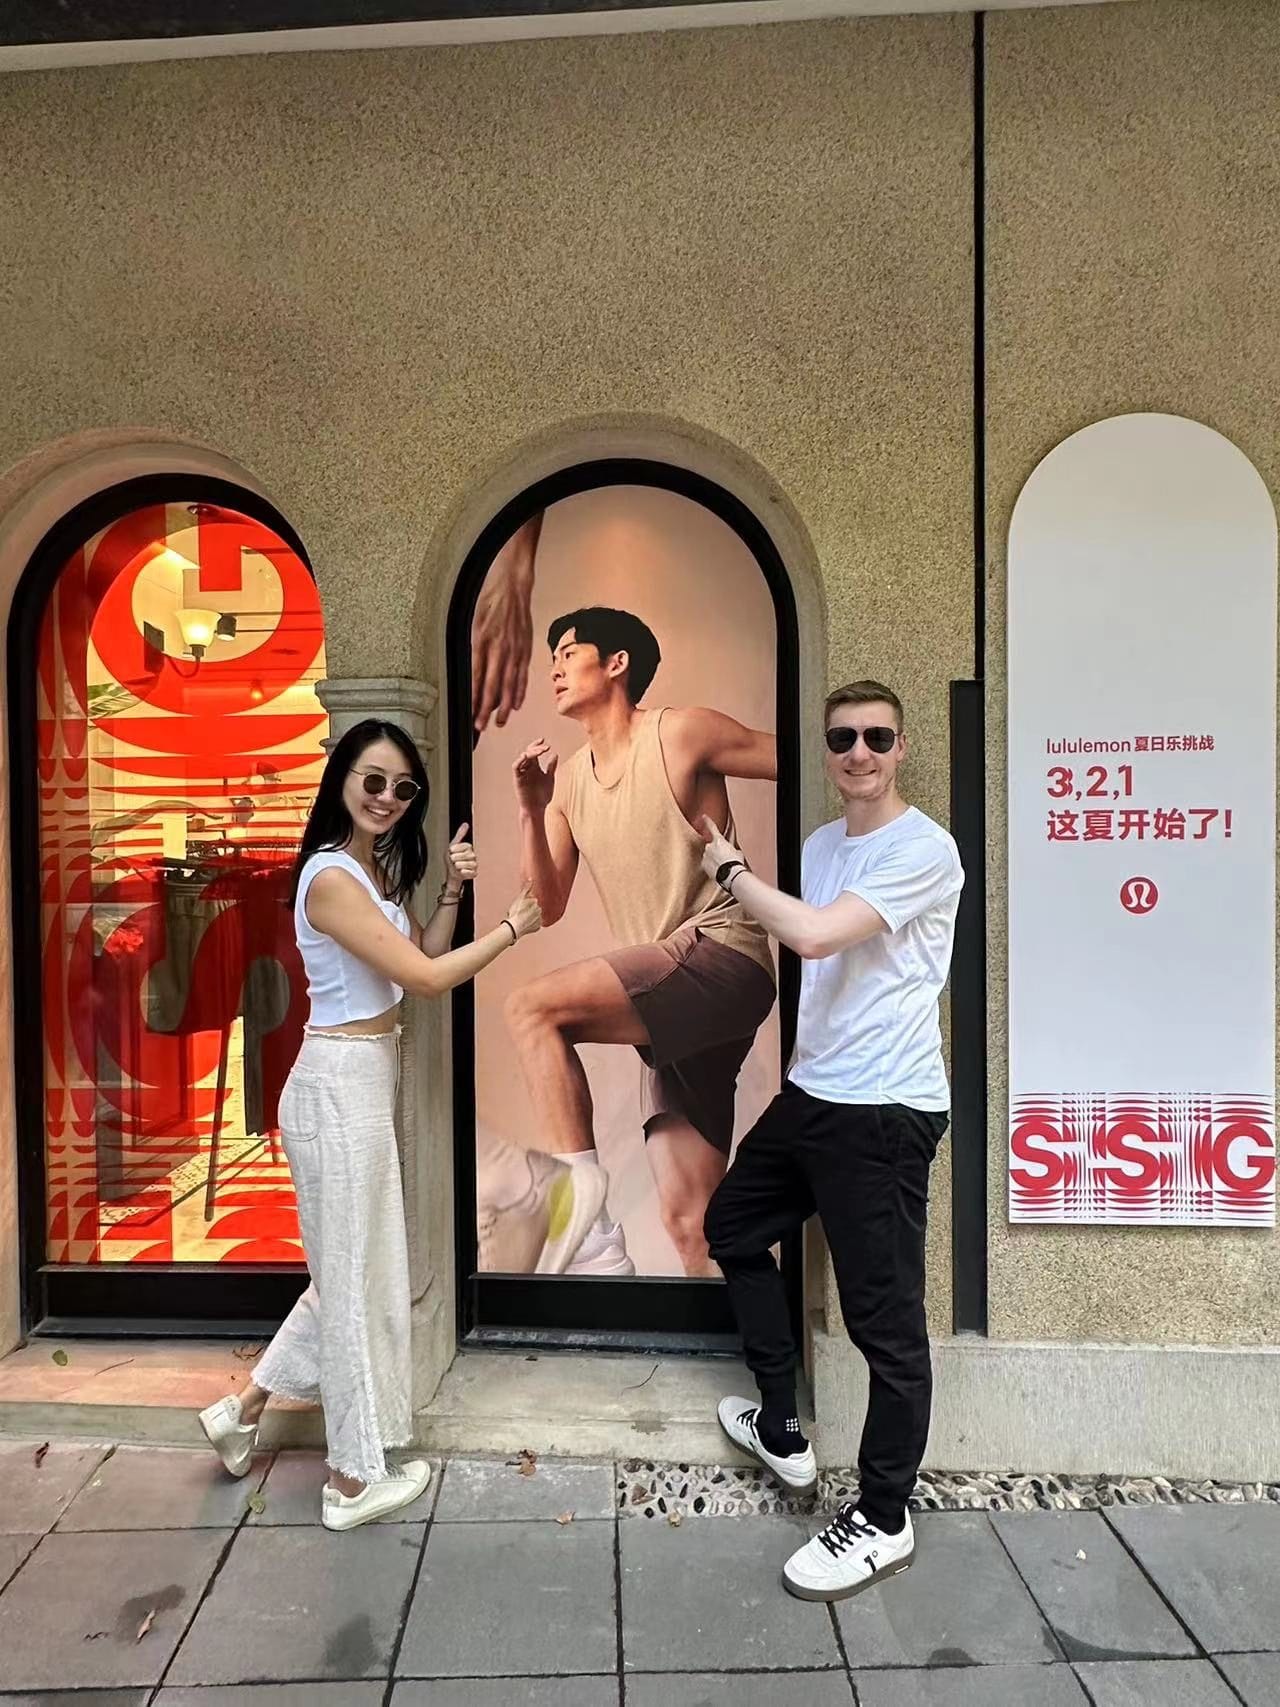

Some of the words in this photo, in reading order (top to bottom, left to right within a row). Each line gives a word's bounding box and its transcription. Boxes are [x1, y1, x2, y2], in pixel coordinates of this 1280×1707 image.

[1046, 738, 1131, 754] lululemon
[1134, 735, 1215, 752] 夏日乐挑战
[1047, 764, 1133, 801] 3,2,1
[1046, 807, 1233, 842] 这夏开始了!
